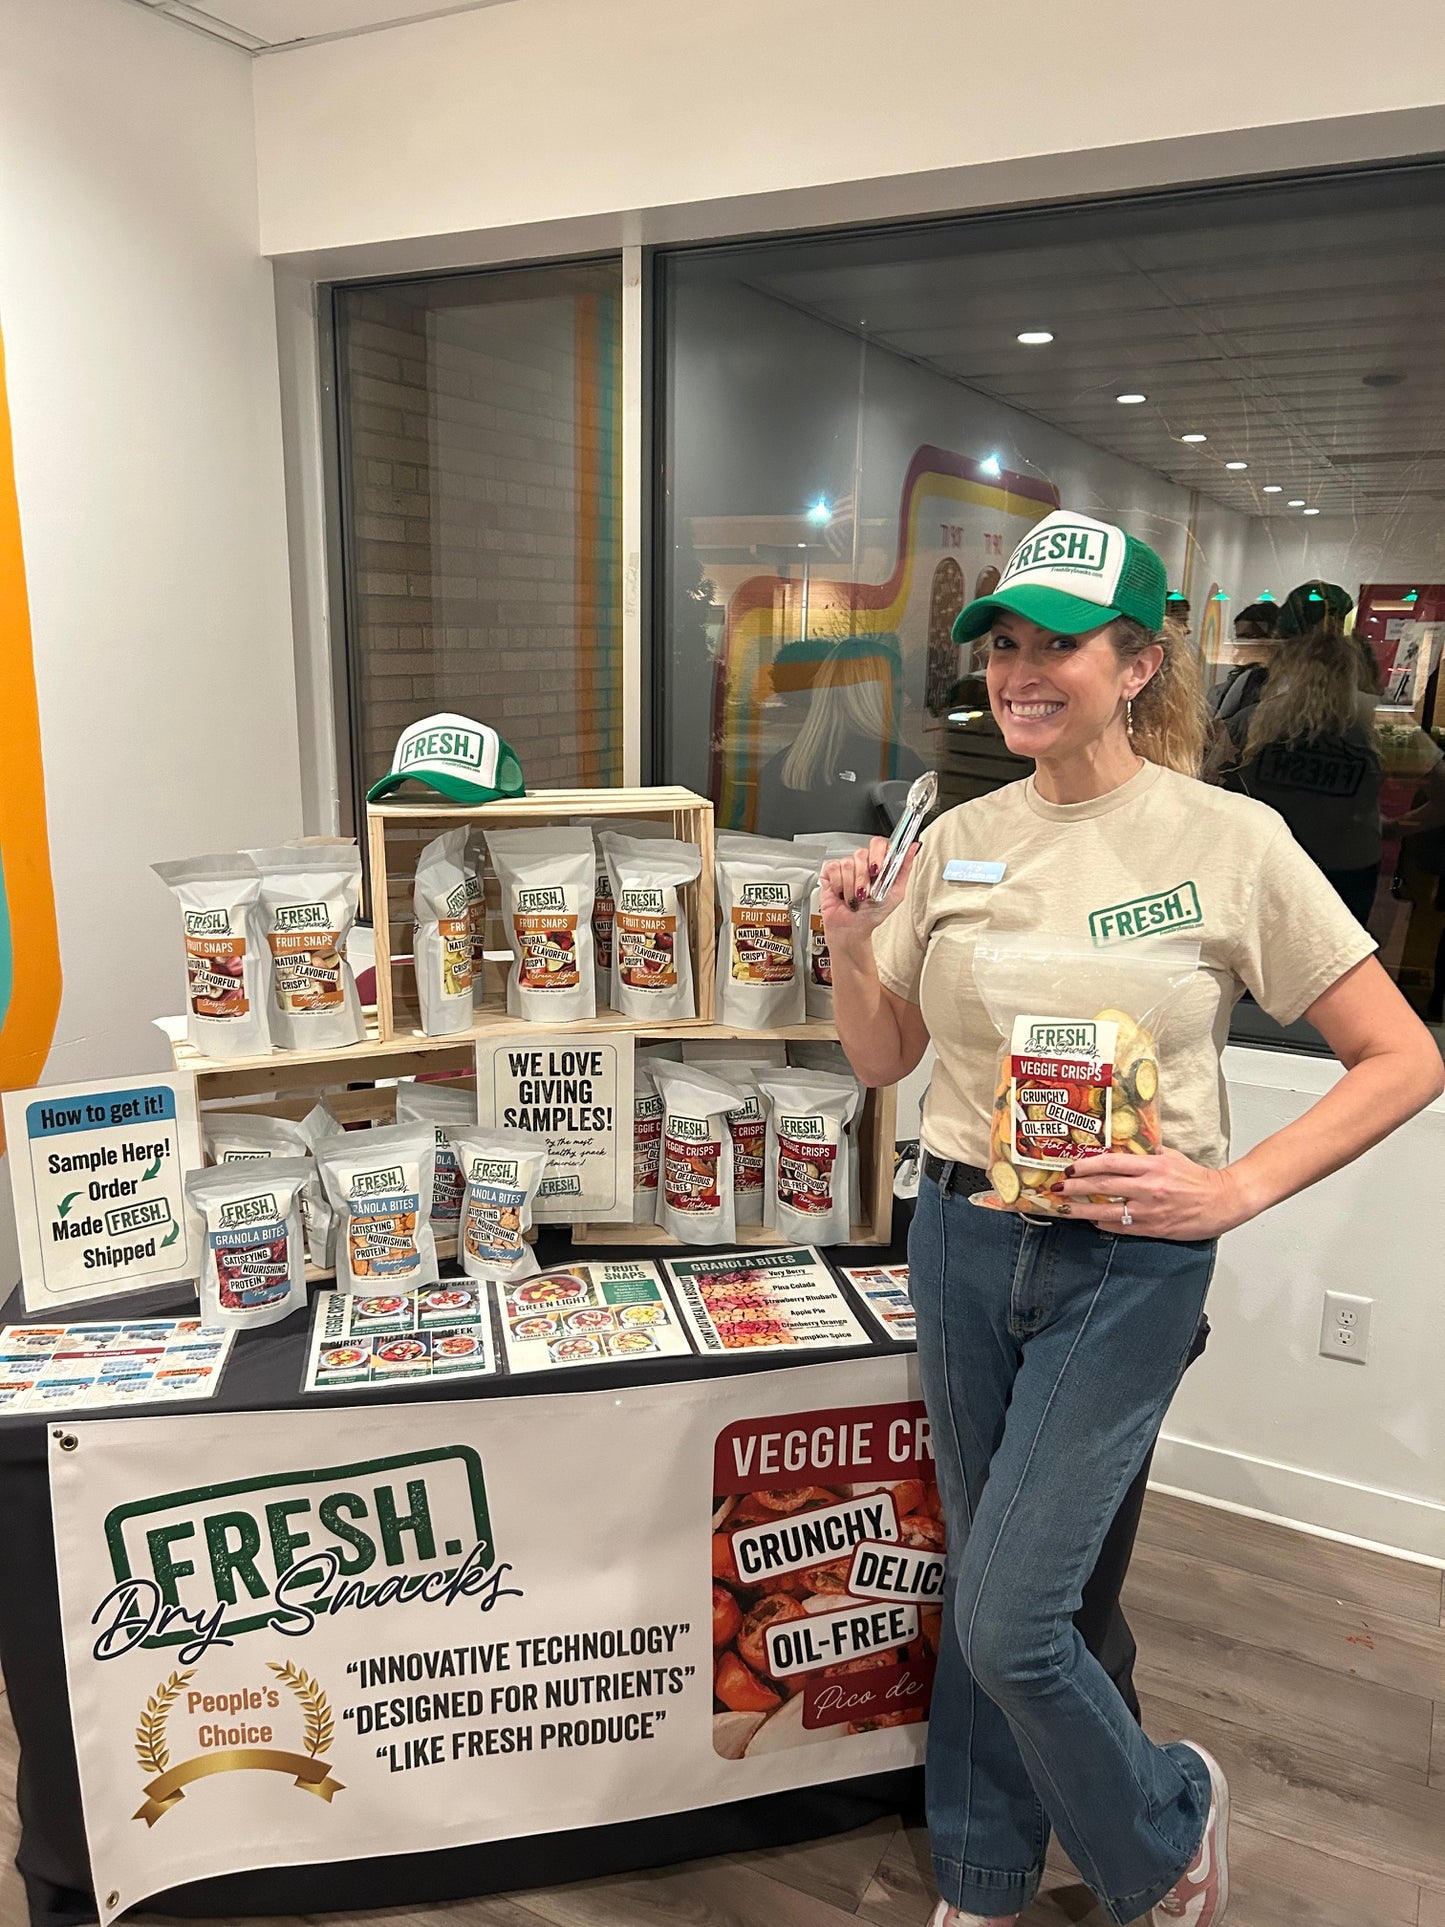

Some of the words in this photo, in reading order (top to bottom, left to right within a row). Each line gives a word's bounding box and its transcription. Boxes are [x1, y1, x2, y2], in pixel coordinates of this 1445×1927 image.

[1004, 532, 1095, 579] FRESH.
[404, 732, 475, 764] FRESH.
[522, 891, 561, 906] FRESH.
[625, 893, 660, 907] FRESH.
[747, 887, 787, 900] FRESH.
[187, 914, 225, 929] FRESH.
[281, 907, 325, 924] FRESH.
[520, 918, 538, 928] FRUIT
[541, 918, 568, 928] SNAPS
[622, 917, 640, 928] FRUIT
[640, 919, 666, 930] SNAPS
[741, 911, 764, 922] FRUIT
[766, 912, 790, 922] SNAPS
[1100, 893, 1192, 939] FRESH.
[204, 942, 233, 953] SNAPS
[276, 937, 301, 947] FRUIT
[303, 935, 333, 946] SNAPS
[533, 945, 571, 961] FLAVORFUL.
[634, 945, 669, 962] FLAVORFUL.
[199, 970, 238, 989] FLAVORFUL.
[1036, 1028, 1091, 1046] FRESH.
[508, 1053, 543, 1077] WE
[549, 1051, 603, 1076] LOVE
[1020, 1060, 1058, 1077] VEGGIE
[1061, 1064, 1103, 1082] CRISPS
[519, 1080, 593, 1104] GIVING
[1023, 1091, 1067, 1103] CRUNCHY.
[41, 1108, 82, 1130] How
[86, 1105, 106, 1123] to
[110, 1099, 141, 1124] get
[144, 1094, 164, 1115] it!
[504, 1107, 613, 1132] SAMPLES!
[1048, 1104, 1097, 1132] DELICIOUS.
[671, 1119, 706, 1135] FRESH.
[738, 1126, 765, 1137] CRISPS
[784, 1120, 821, 1134] FRESH.
[1024, 1123, 1066, 1135] OIL-FREE.
[557, 1137, 572, 1146] the
[573, 1137, 594, 1146] most
[48, 1146, 118, 1175] Sample
[122, 1138, 171, 1163] Here!
[580, 1147, 607, 1158] snack
[686, 1145, 714, 1156] CRISPS
[801, 1146, 830, 1157] CRISPS
[476, 1162, 514, 1179] FRESH.
[88, 1178, 138, 1201] Order
[357, 1172, 401, 1190] FRESH.
[542, 1179, 577, 1193] FRESH.
[390, 1198, 414, 1211] BITES
[498, 1191, 521, 1205] BITES
[226, 1198, 274, 1221] FRESH.
[52, 1216, 103, 1242] Made
[111, 1204, 166, 1231] FRESH.
[215, 1232, 260, 1246] GRANOLA
[262, 1225, 285, 1240] BITES
[84, 1238, 156, 1269] Shipped
[355, 1248, 389, 1259] PROTEIN.
[604, 1264, 640, 1273] FRUIT
[690, 1259, 755, 1272] GRANOLA
[756, 1254, 796, 1266] BITES
[230, 1276, 264, 1290] PROTEIN.
[604, 1271, 647, 1280] SNAPS
[790, 1281, 816, 1289] Colada
[518, 1300, 554, 1312] GREEN
[556, 1296, 587, 1307] LIGHT
[763, 1297, 805, 1306] Strawberry
[805, 1293, 838, 1301] Rhubarb
[324, 1313, 344, 1338] VEGGIE
[441, 1327, 473, 1336] GREEK
[781, 1320, 819, 1328] Cranberry
[820, 1318, 848, 1326] Orange
[330, 1339, 363, 1348] CURRY
[793, 1333, 829, 1341] Pumpkin
[829, 1331, 852, 1339] Spice
[732, 1422, 874, 1478] VEGGIE
[146, 1479, 463, 1607] FRESH.
[738, 1504, 892, 1574] CRUNCHY.
[91, 1578, 235, 1665] Dry
[267, 1540, 524, 1637] Snacks
[771, 1607, 915, 1670] OIL-FREE.
[346, 1644, 511, 1689] “INNOVATIVE
[516, 1623, 692, 1667] TECHNOLOGY”
[187, 1684, 280, 1717] People’s
[342, 1689, 484, 1737] “DESIGNED
[490, 1683, 540, 1715] FOR
[545, 1666, 696, 1711] NUTRIENTS”
[813, 1684, 877, 1720] Pico
[884, 1671, 925, 1699] de
[198, 1723, 273, 1749] Choice
[376, 1740, 446, 1774] “LIKE
[452, 1727, 533, 1761] FRESH
[539, 1710, 667, 1751] PRODUCE”
